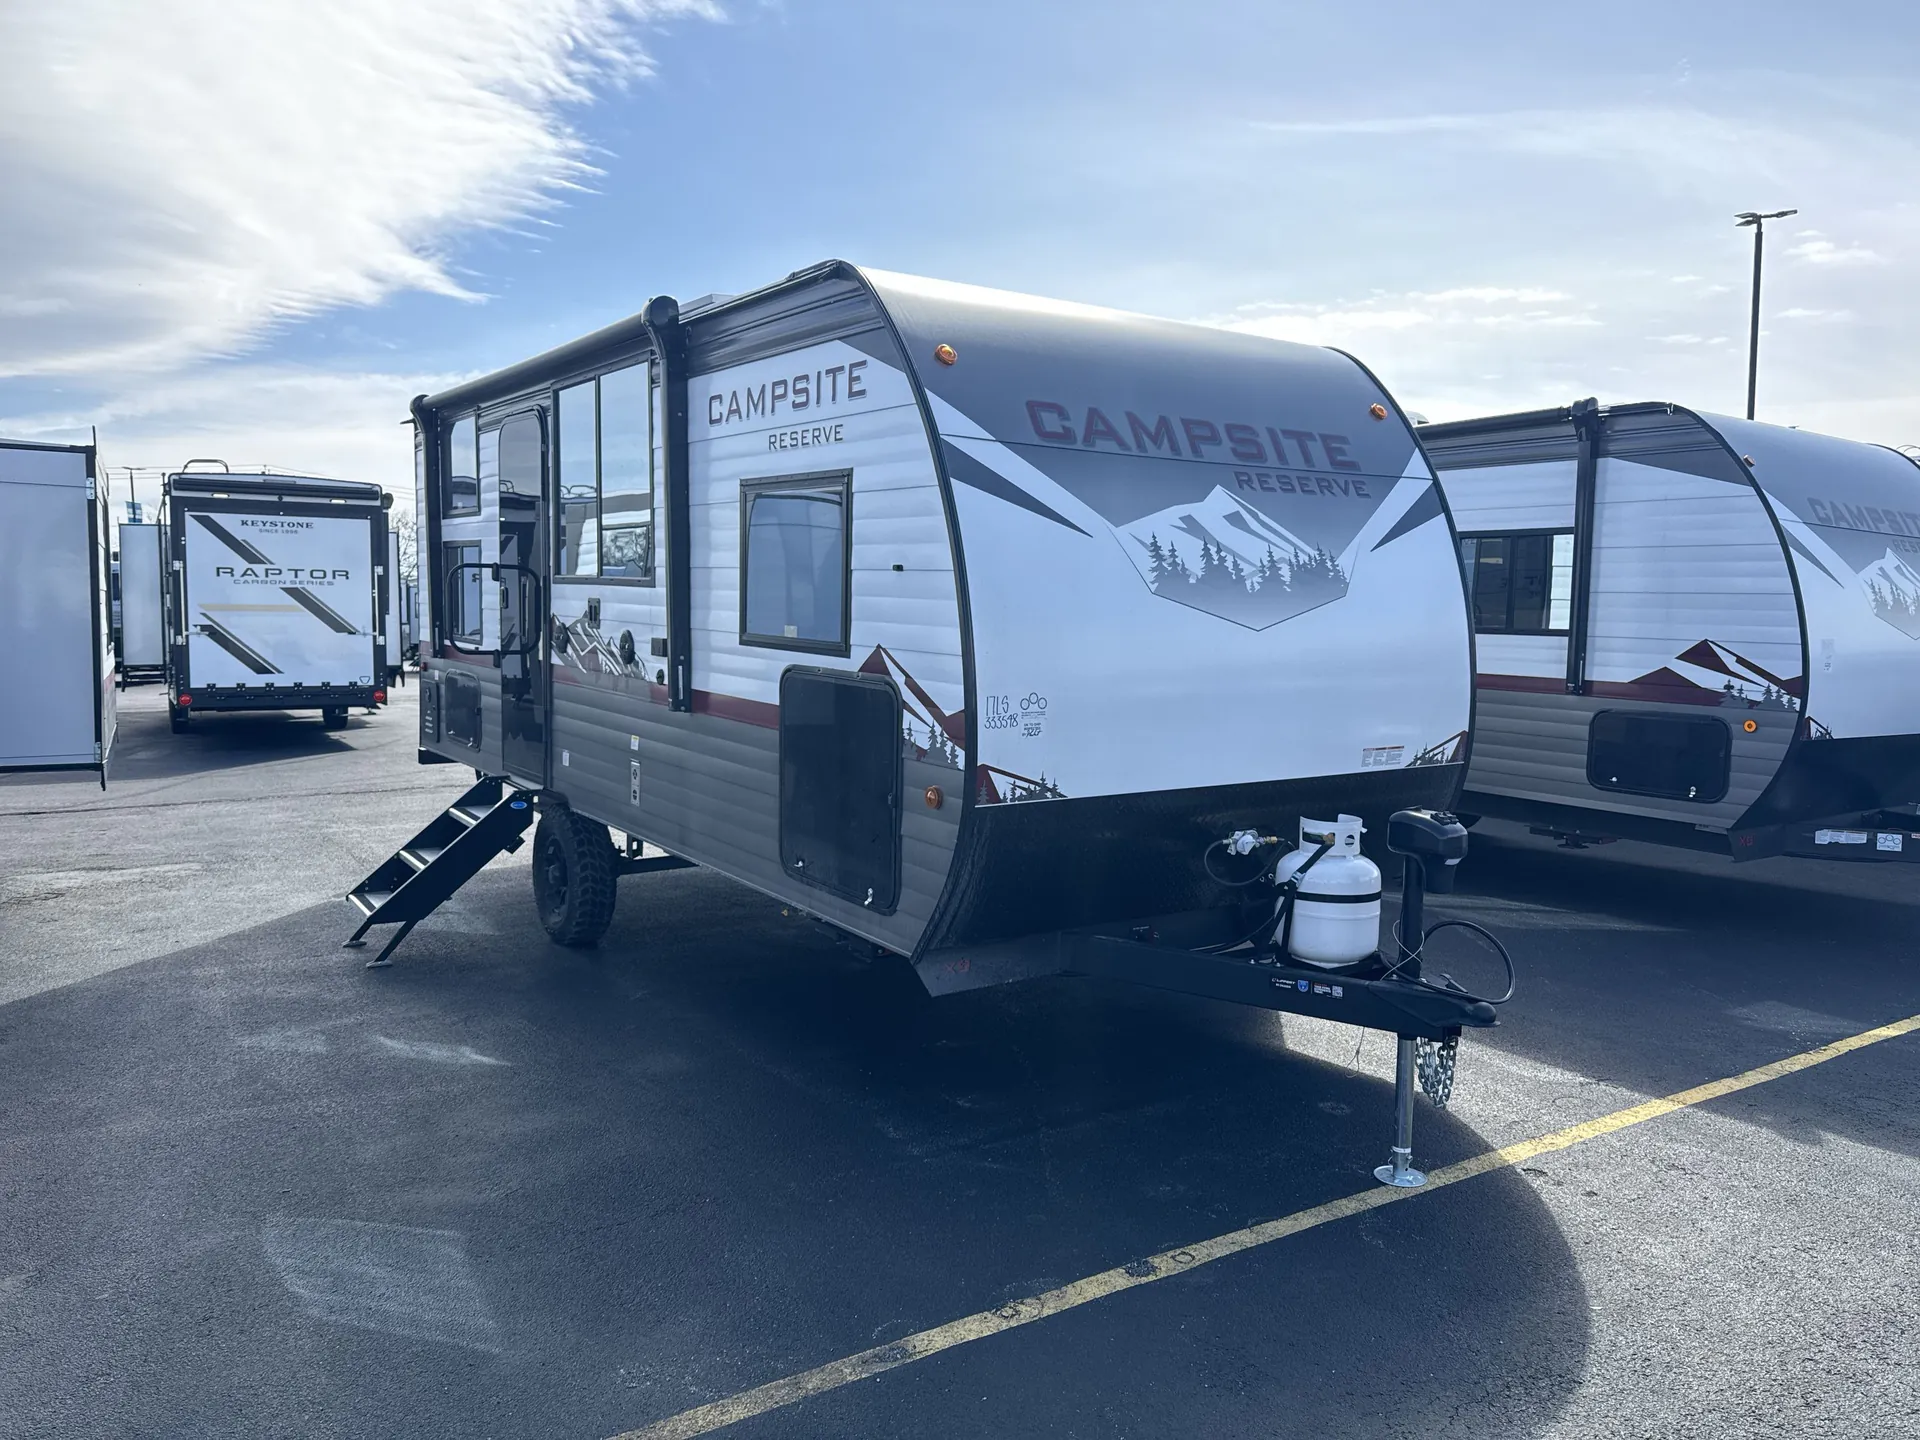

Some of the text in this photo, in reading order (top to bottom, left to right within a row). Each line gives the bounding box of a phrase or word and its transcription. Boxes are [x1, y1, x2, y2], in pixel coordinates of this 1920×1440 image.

[708, 359, 867, 427] CAMPSITE
[768, 424, 844, 451] RESERVE
[1025, 399, 1362, 472] CAMPSITE
[1233, 471, 1372, 499] RESERVE
[240, 519, 314, 529] KEYSTONE
[1806, 497, 1920, 536] CAMPSIT
[216, 566, 350, 580] RAPTOR
